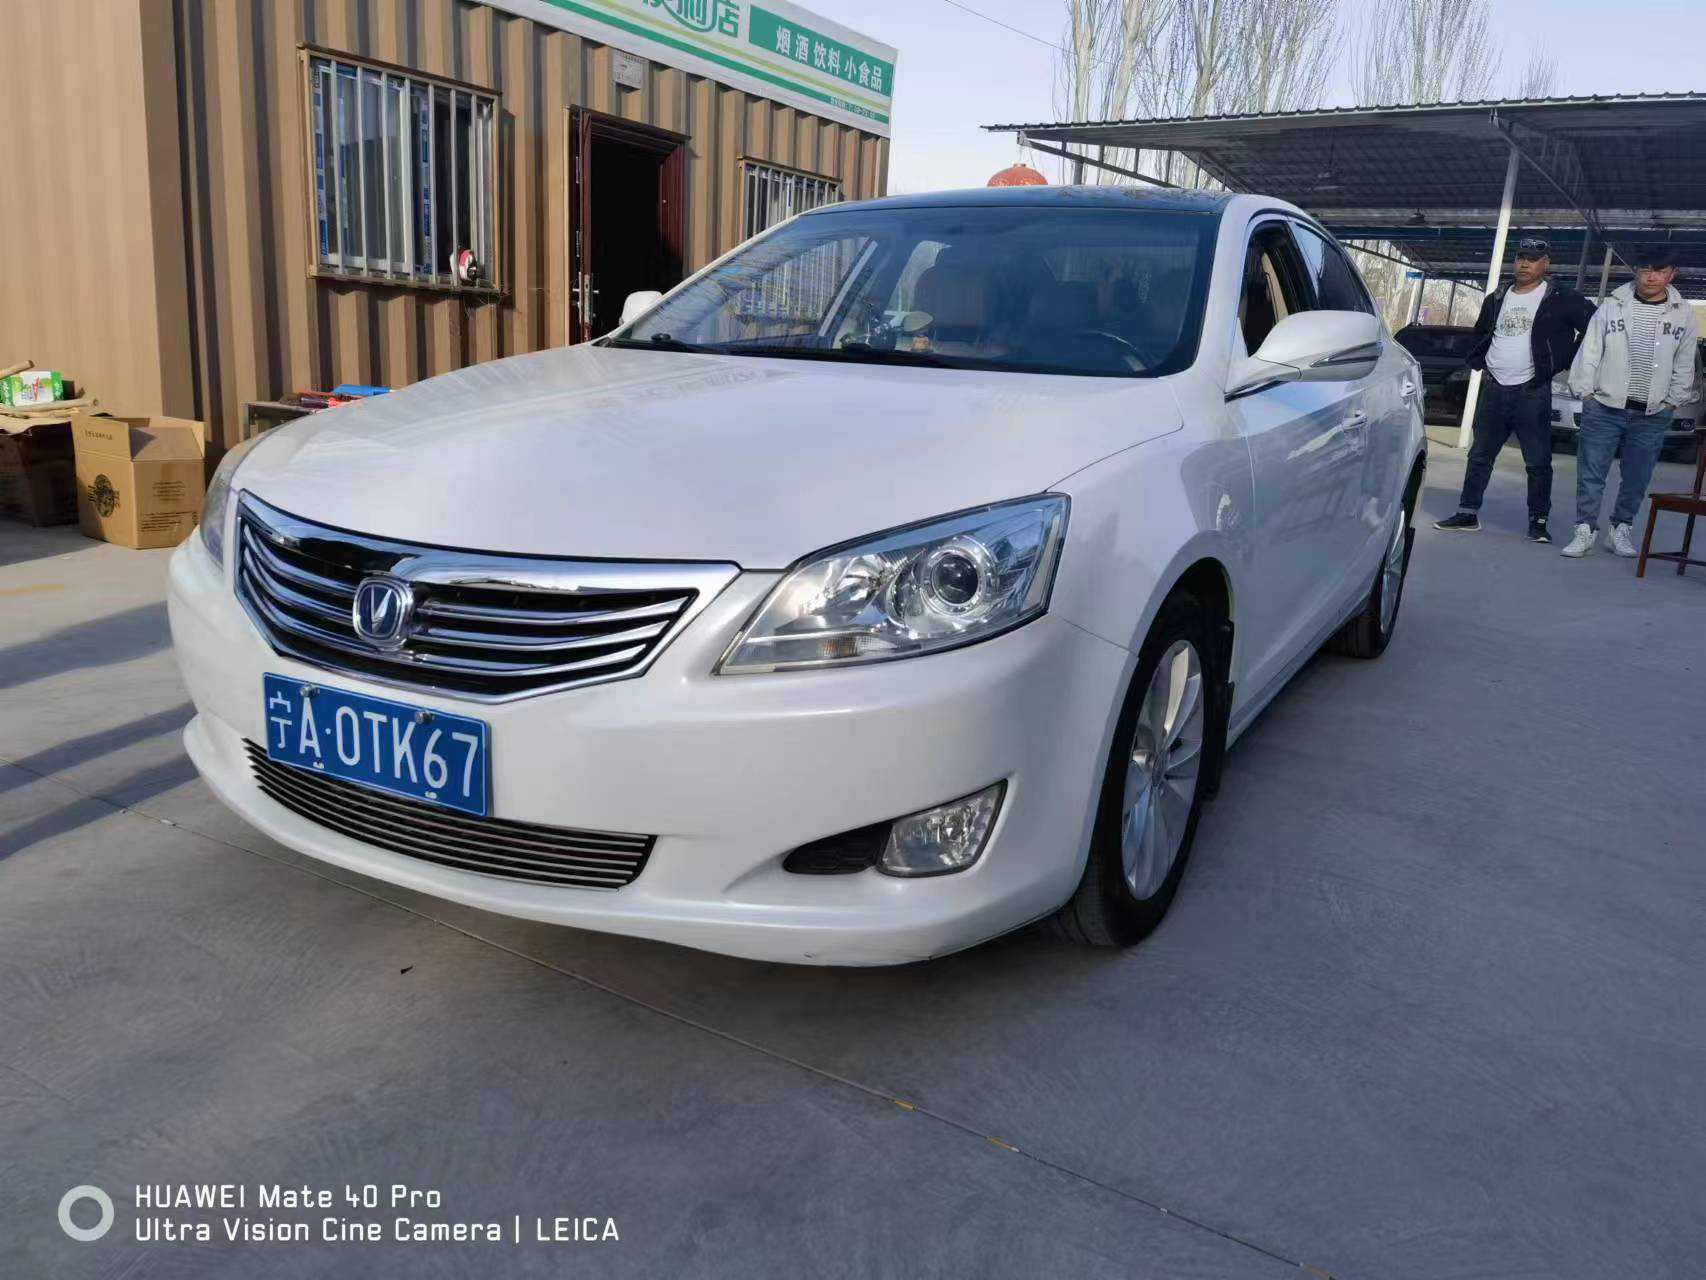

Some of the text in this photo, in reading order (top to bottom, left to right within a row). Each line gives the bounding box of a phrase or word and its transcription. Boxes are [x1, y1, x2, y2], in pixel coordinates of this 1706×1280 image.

[776, 25, 882, 91] 烟酒饮料小食品
